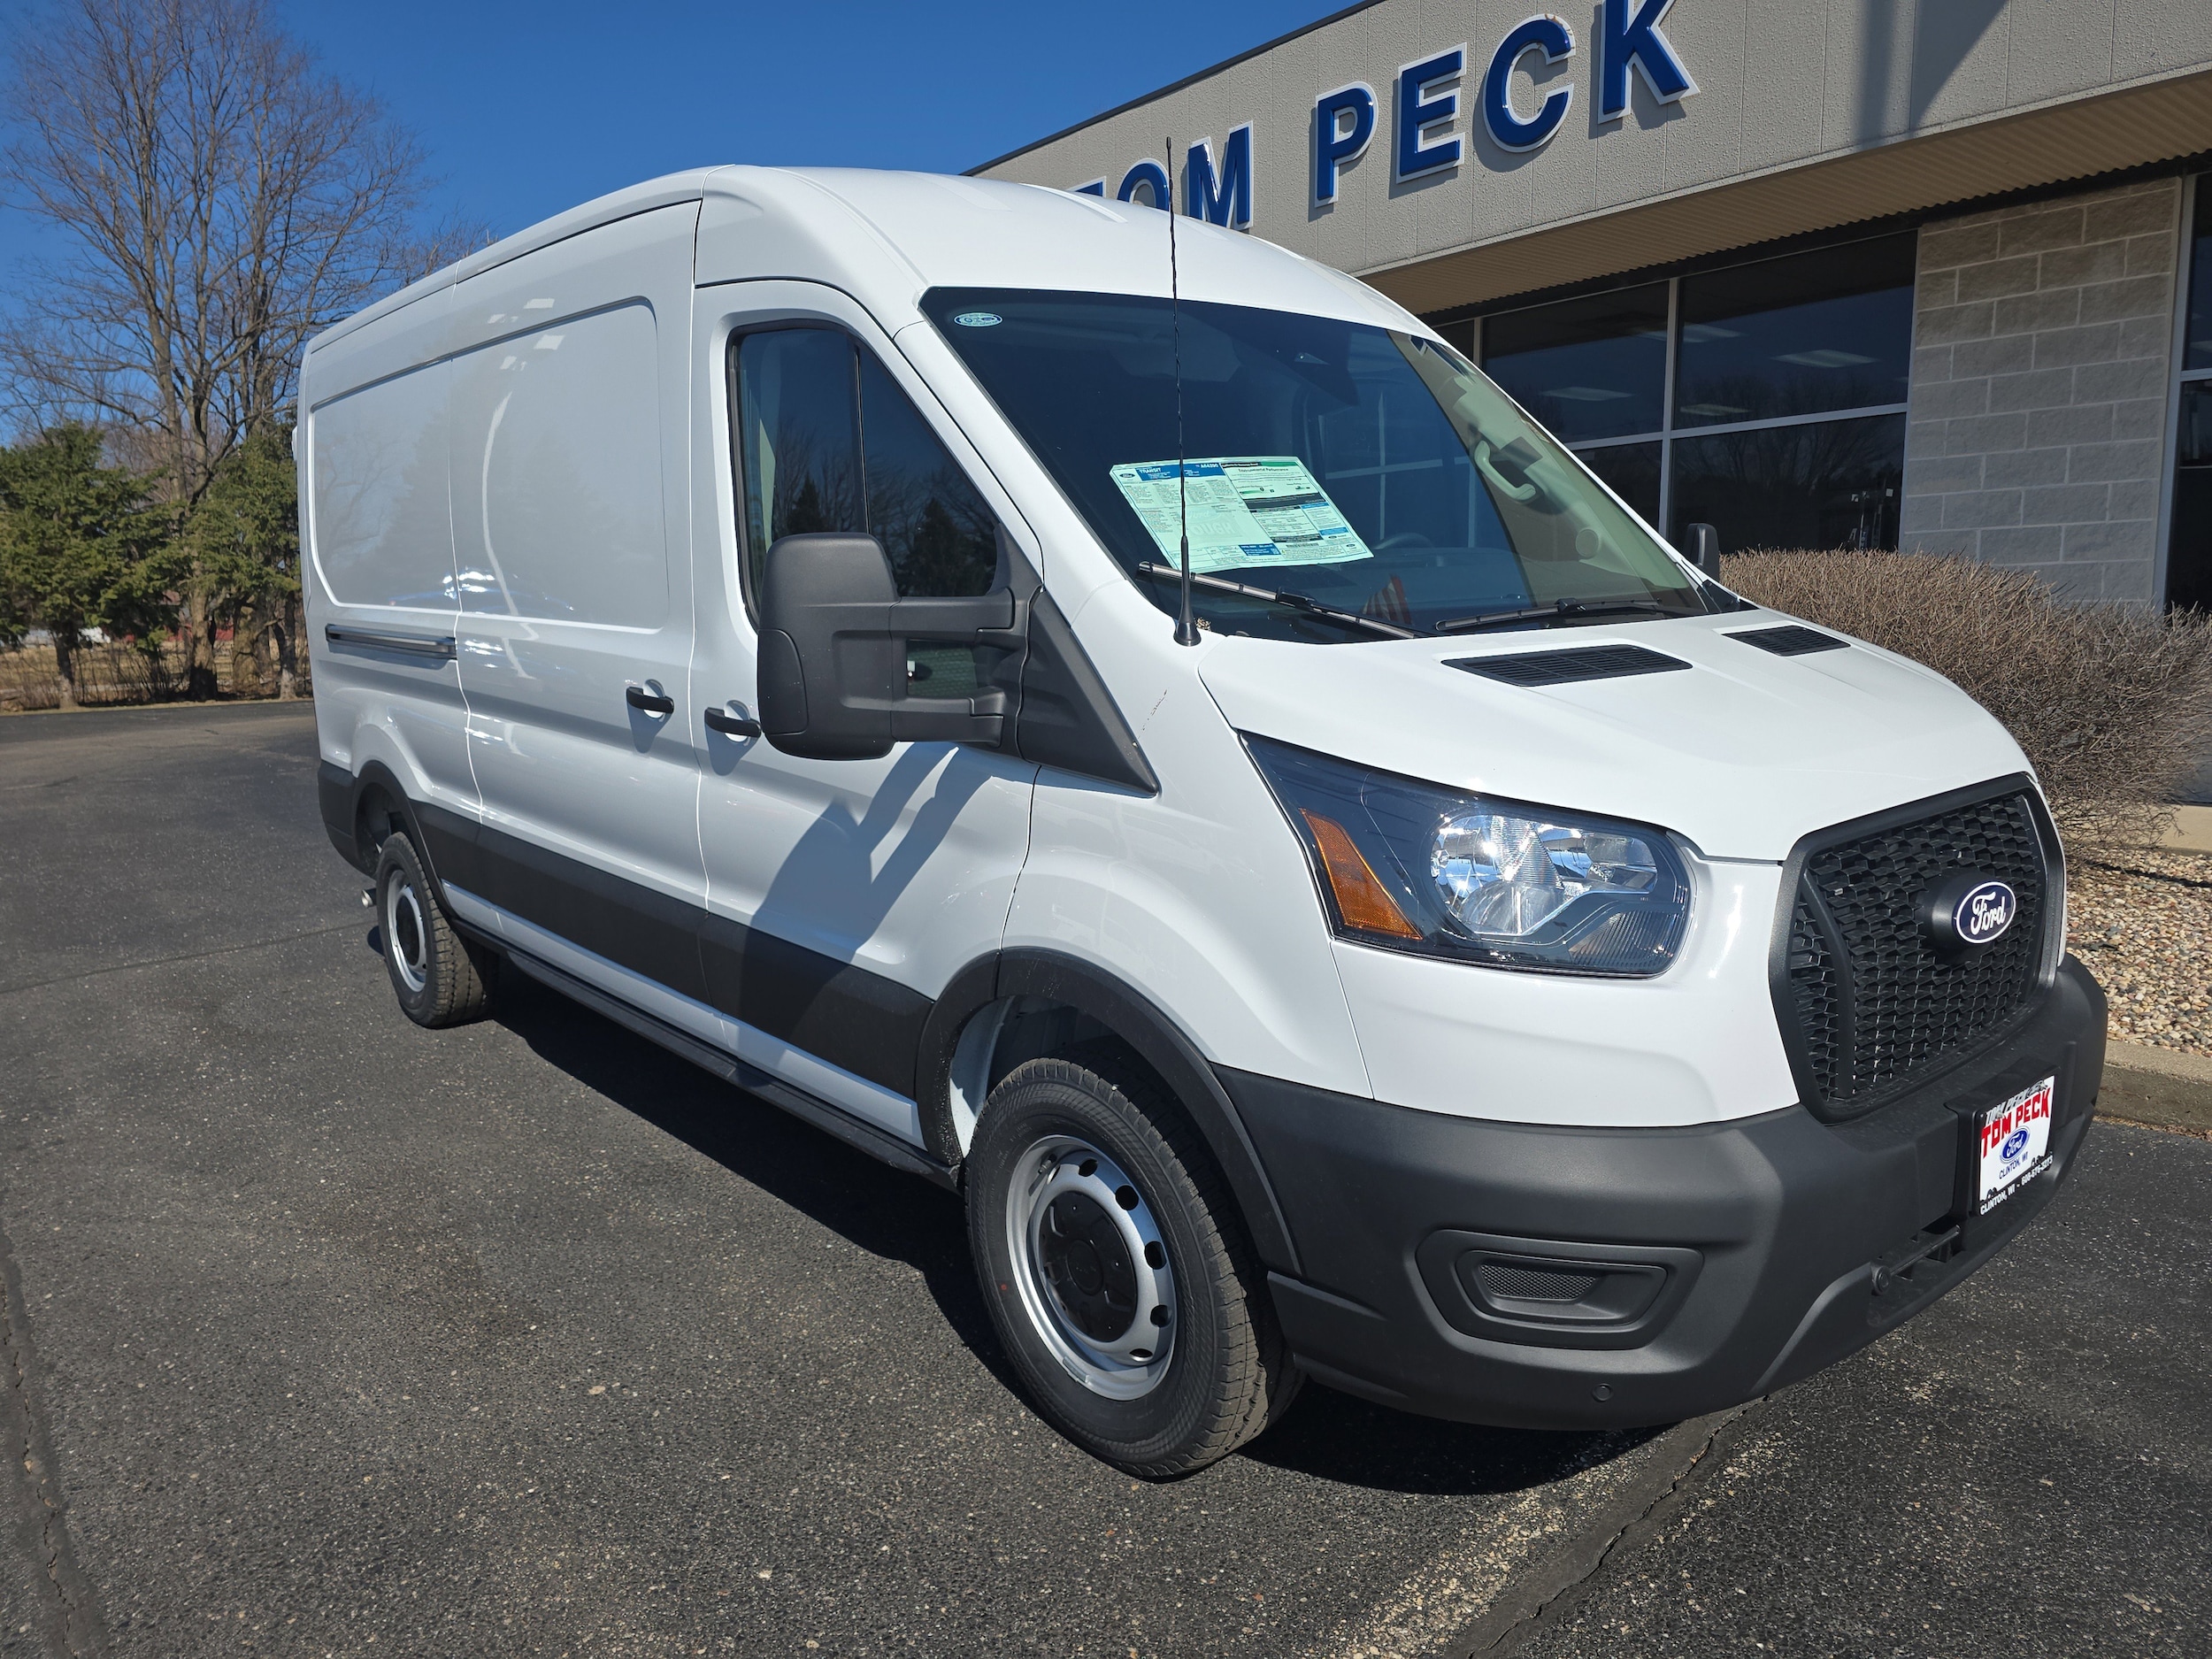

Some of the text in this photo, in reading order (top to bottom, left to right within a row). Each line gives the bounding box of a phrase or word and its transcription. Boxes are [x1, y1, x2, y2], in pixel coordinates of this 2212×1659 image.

[1069, 0, 1700, 229] OM PECK
[1970, 891, 2007, 935] Ford
[1981, 1087, 2051, 1158] TOM PECK
[2006, 1131, 2025, 1158] Ford
[1980, 1190, 2008, 1215] CLINTON,
